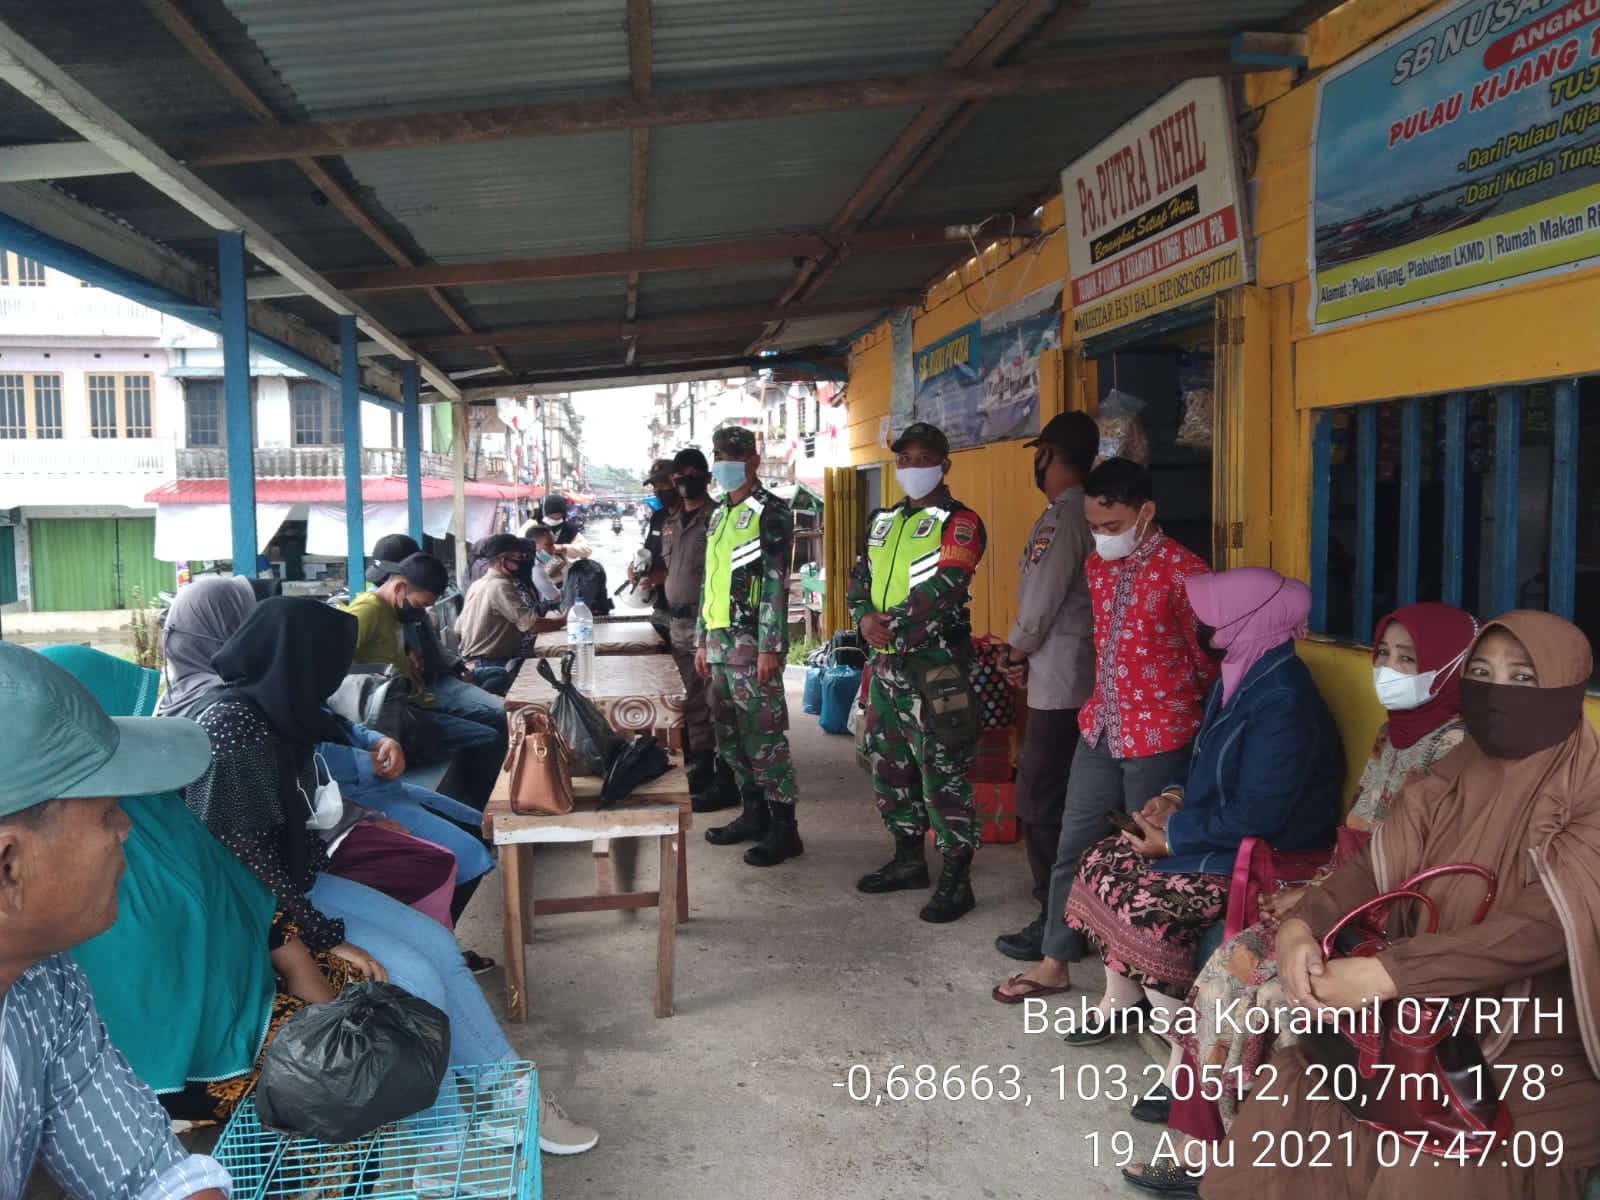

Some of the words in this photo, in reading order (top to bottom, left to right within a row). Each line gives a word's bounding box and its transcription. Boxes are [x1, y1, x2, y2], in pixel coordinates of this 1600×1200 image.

[1391, 37, 1436, 85] SB
[1438, 0, 1551, 64] NUSA
[1388, 92, 1463, 147] PULAU
[1469, 38, 1579, 113] KIJANG
[1149, 101, 1207, 195] INHIL
[1465, 174, 1502, 207] Dari
[1502, 159, 1555, 192] Kuala
[1466, 137, 1504, 173] Dari
[1504, 120, 1559, 158] Pulau
[1321, 283, 1347, 303] Alamat
[1352, 275, 1376, 294] Pulau
[1408, 252, 1452, 279] Plabuhan
[1454, 240, 1485, 267] LKMD
[1496, 225, 1537, 255] Rumah
[1539, 215, 1583, 242] Makan
